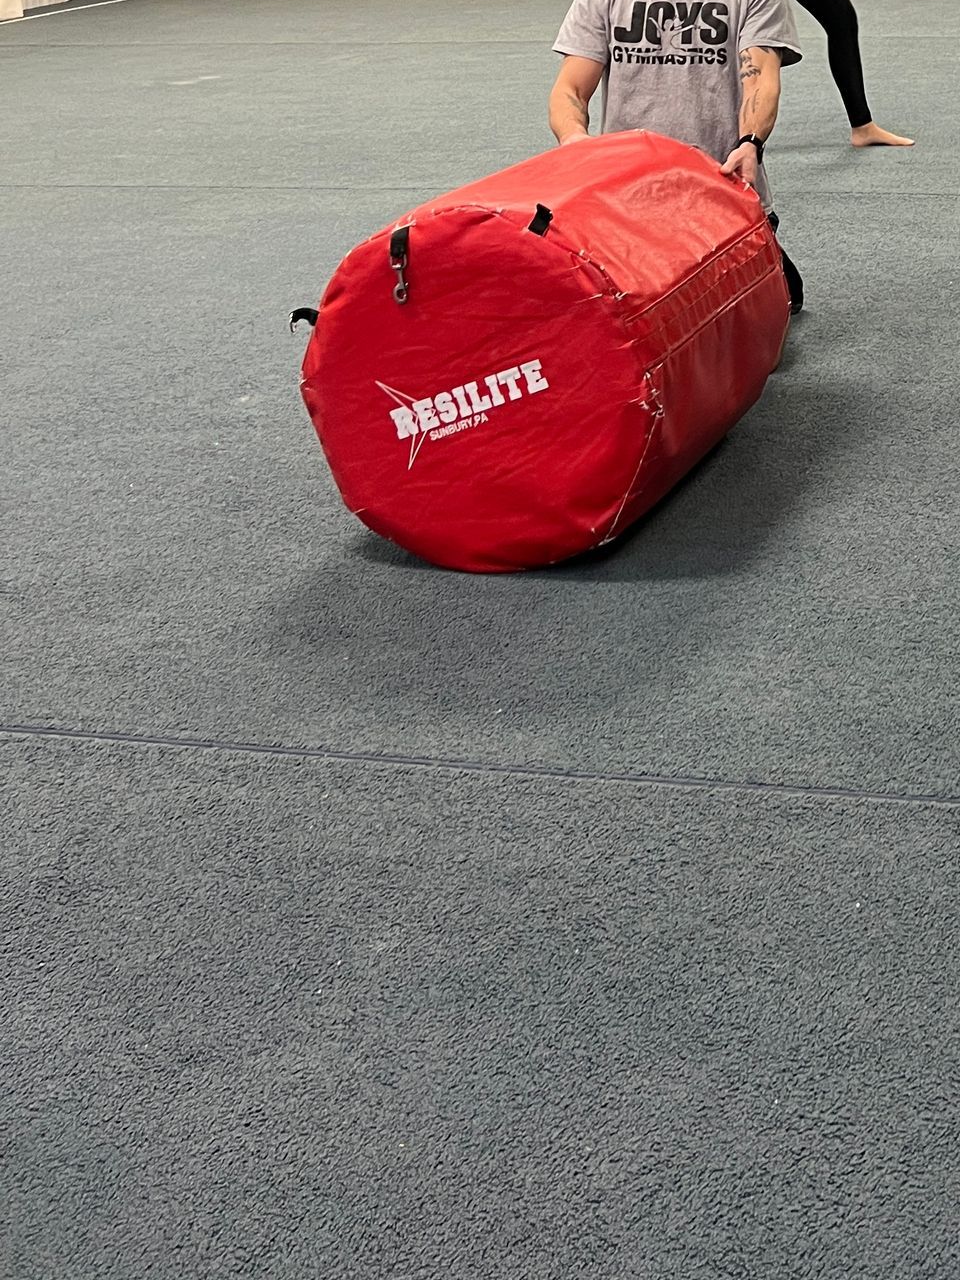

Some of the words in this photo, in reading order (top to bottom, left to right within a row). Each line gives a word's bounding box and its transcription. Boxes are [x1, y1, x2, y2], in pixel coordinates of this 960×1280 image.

[613, 1, 729, 45] JOYS
[612, 46, 728, 66] GYMNASTICS
[389, 359, 550, 440] RESILITE
